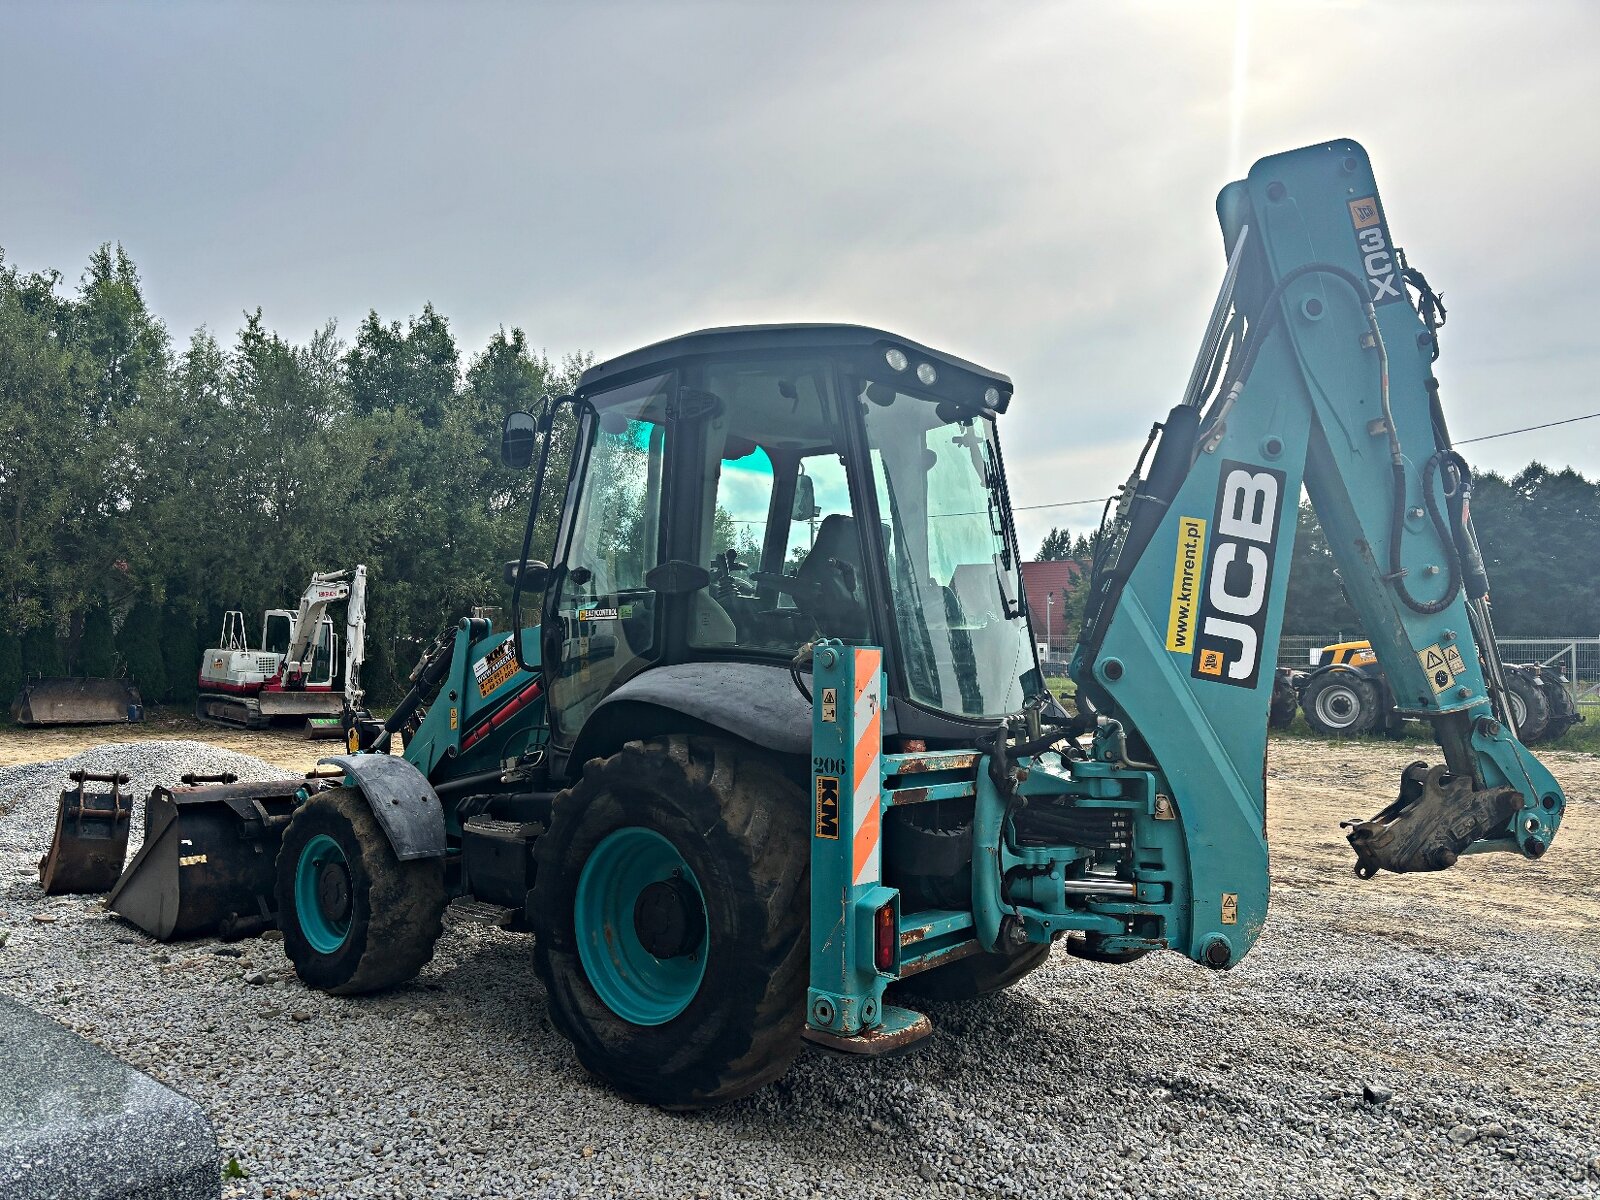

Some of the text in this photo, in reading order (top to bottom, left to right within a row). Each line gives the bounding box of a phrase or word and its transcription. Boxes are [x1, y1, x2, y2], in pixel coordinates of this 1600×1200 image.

[1356, 206, 1375, 221] JCB
[1358, 227, 1401, 301] 3CX
[1175, 521, 1202, 648] www.kmrent.pl
[1203, 469, 1278, 681] JCB
[813, 757, 847, 775] 206
[822, 779, 838, 837] KM
